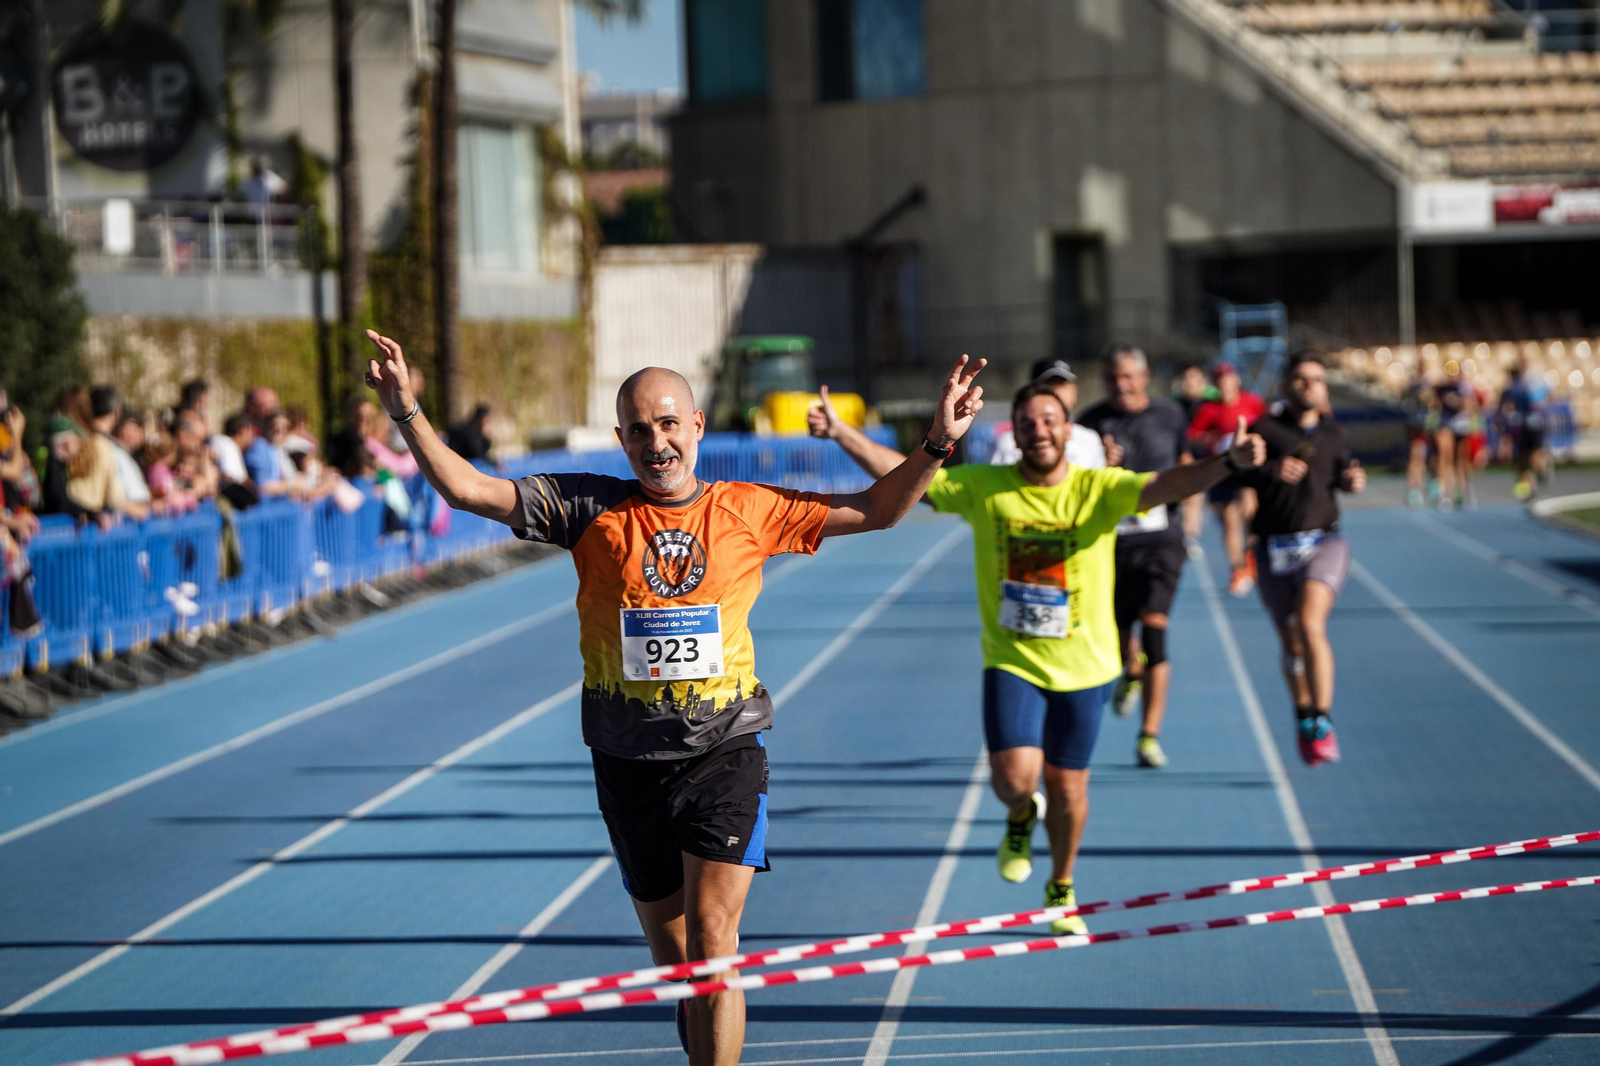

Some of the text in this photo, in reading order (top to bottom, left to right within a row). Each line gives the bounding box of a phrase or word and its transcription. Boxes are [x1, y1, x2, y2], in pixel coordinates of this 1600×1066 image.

[655, 532, 693, 545] BEER
[652, 611, 680, 619] Carrera
[681, 609, 709, 618] Popular
[645, 637, 700, 664] 923
